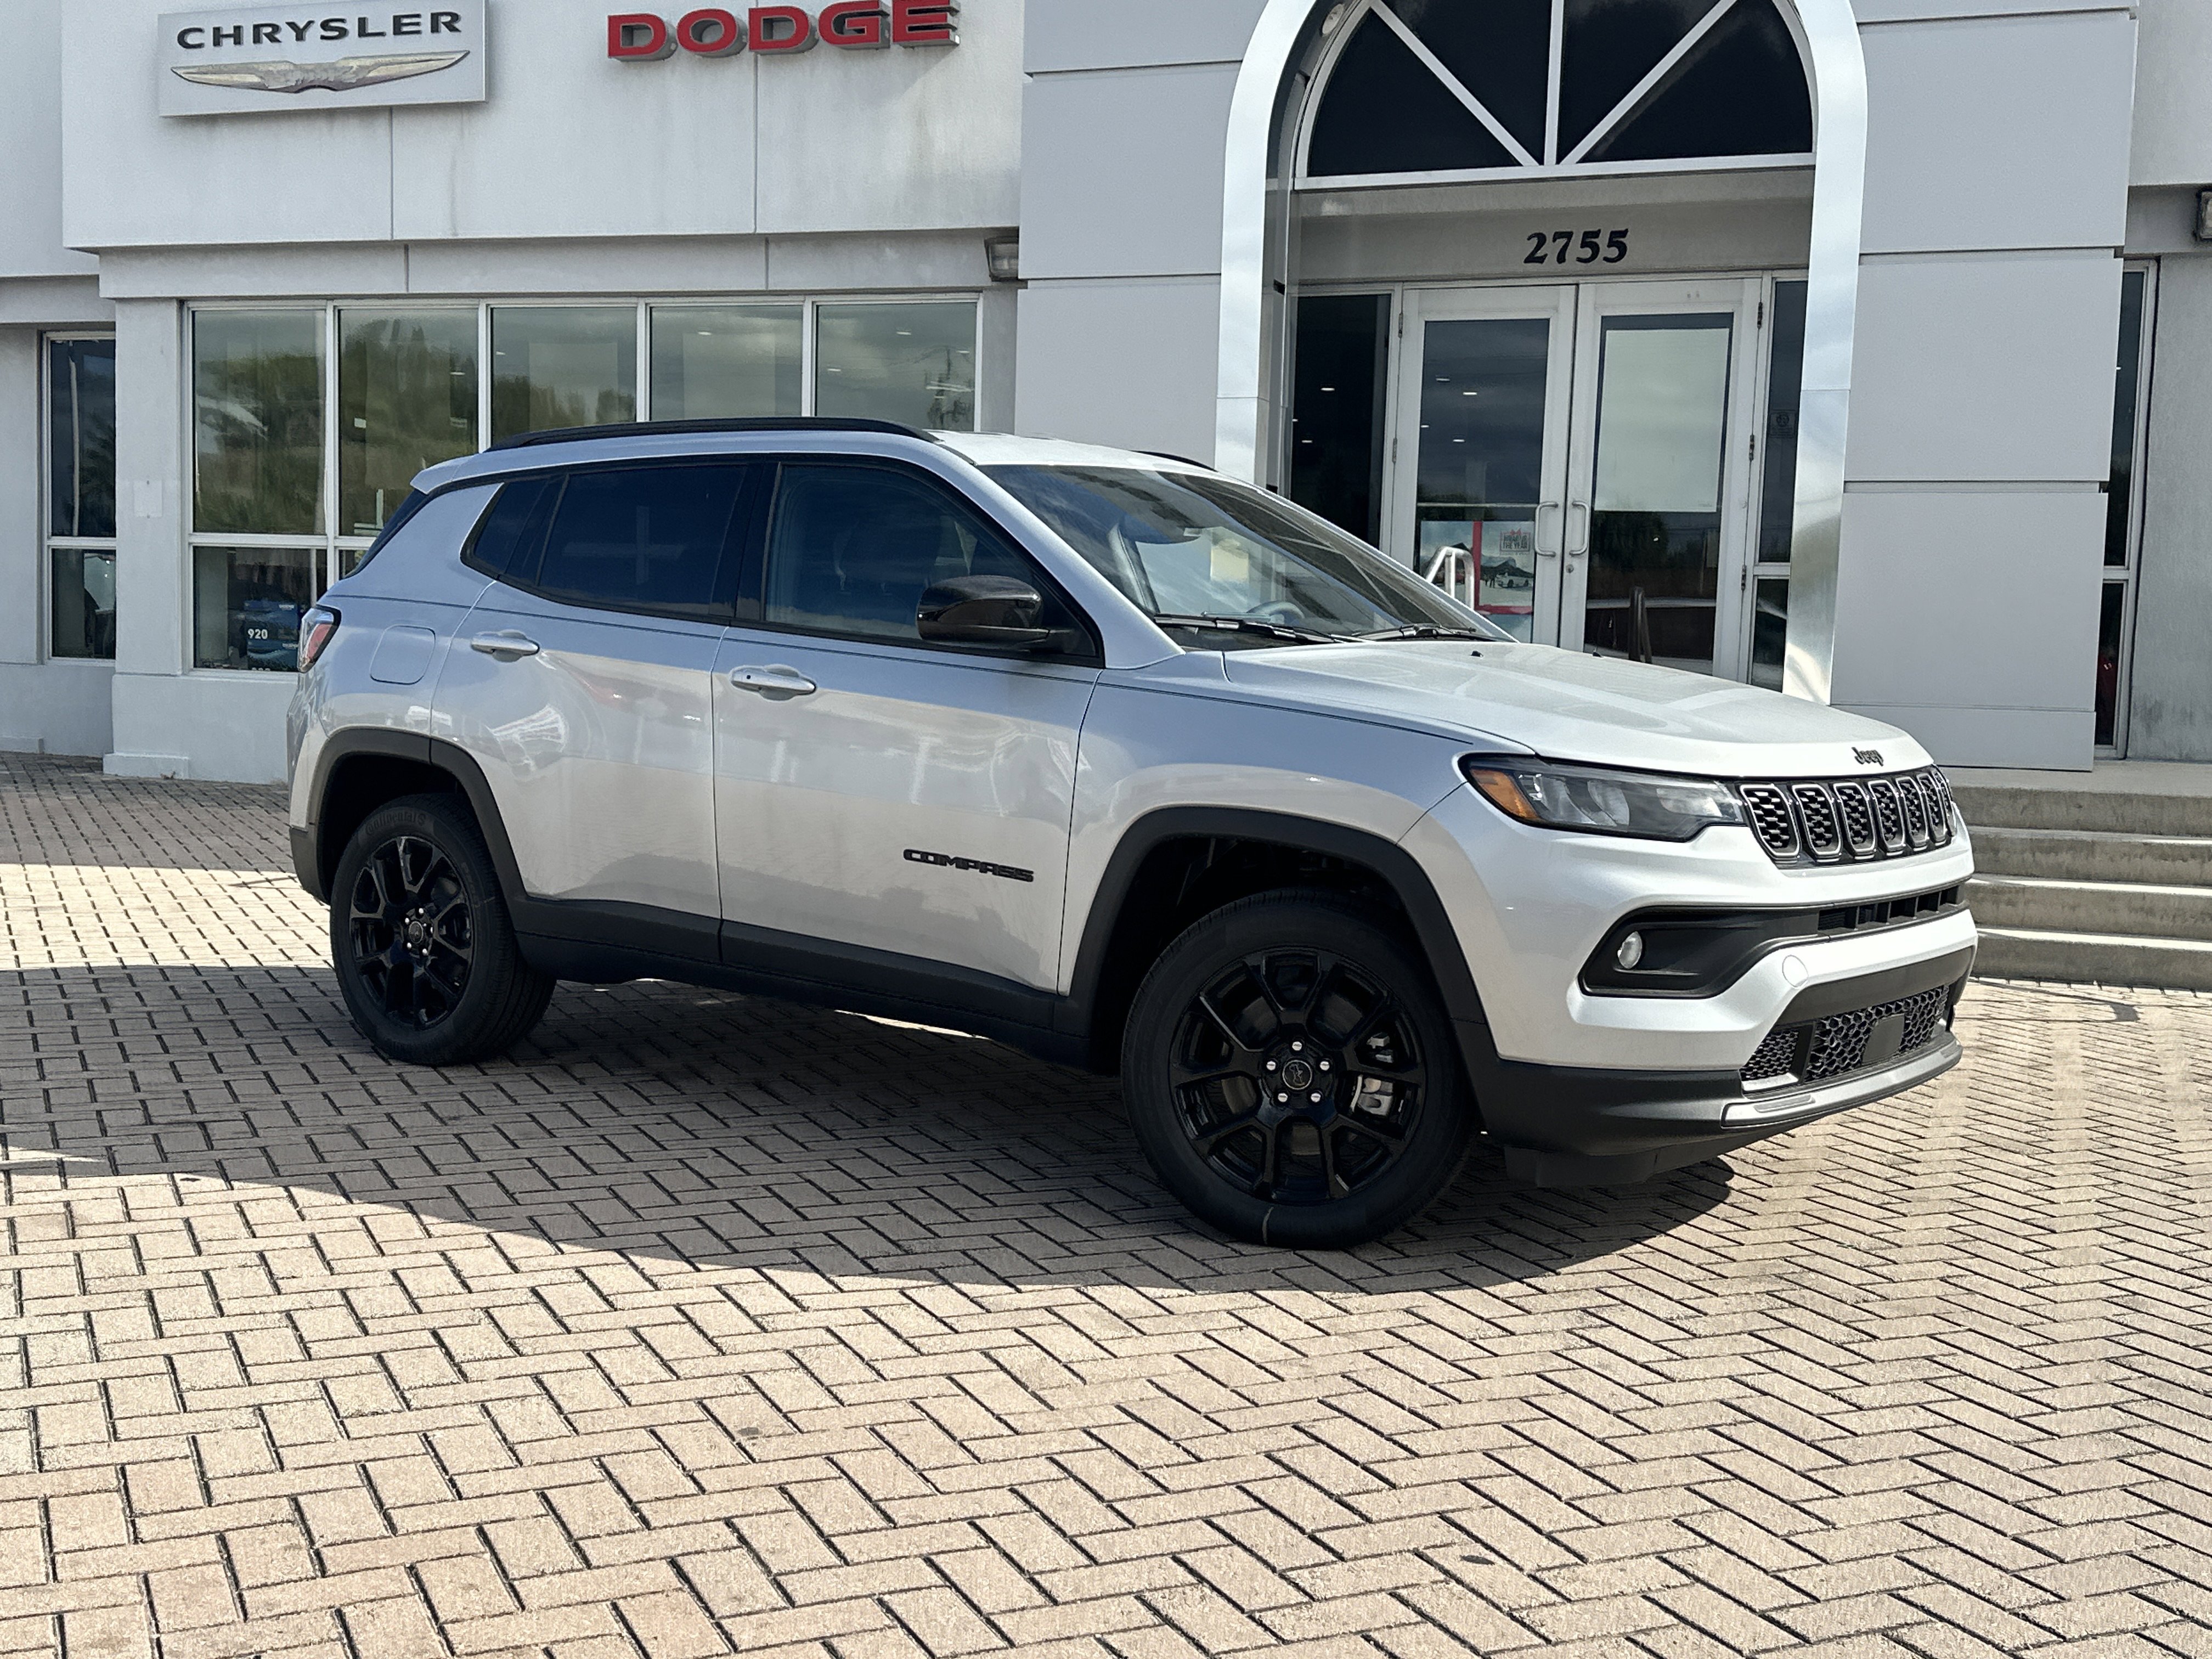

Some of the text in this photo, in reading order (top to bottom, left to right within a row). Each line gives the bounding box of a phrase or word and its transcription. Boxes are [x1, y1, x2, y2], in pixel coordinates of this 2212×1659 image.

[177, 11, 462, 50] CHRYSLER
[607, 0, 957, 60] DODGE
[1523, 228, 1628, 264] 2755
[248, 629, 268, 640] 920
[1851, 747, 1884, 767] Jeep
[904, 849, 1034, 882] COMPASS
